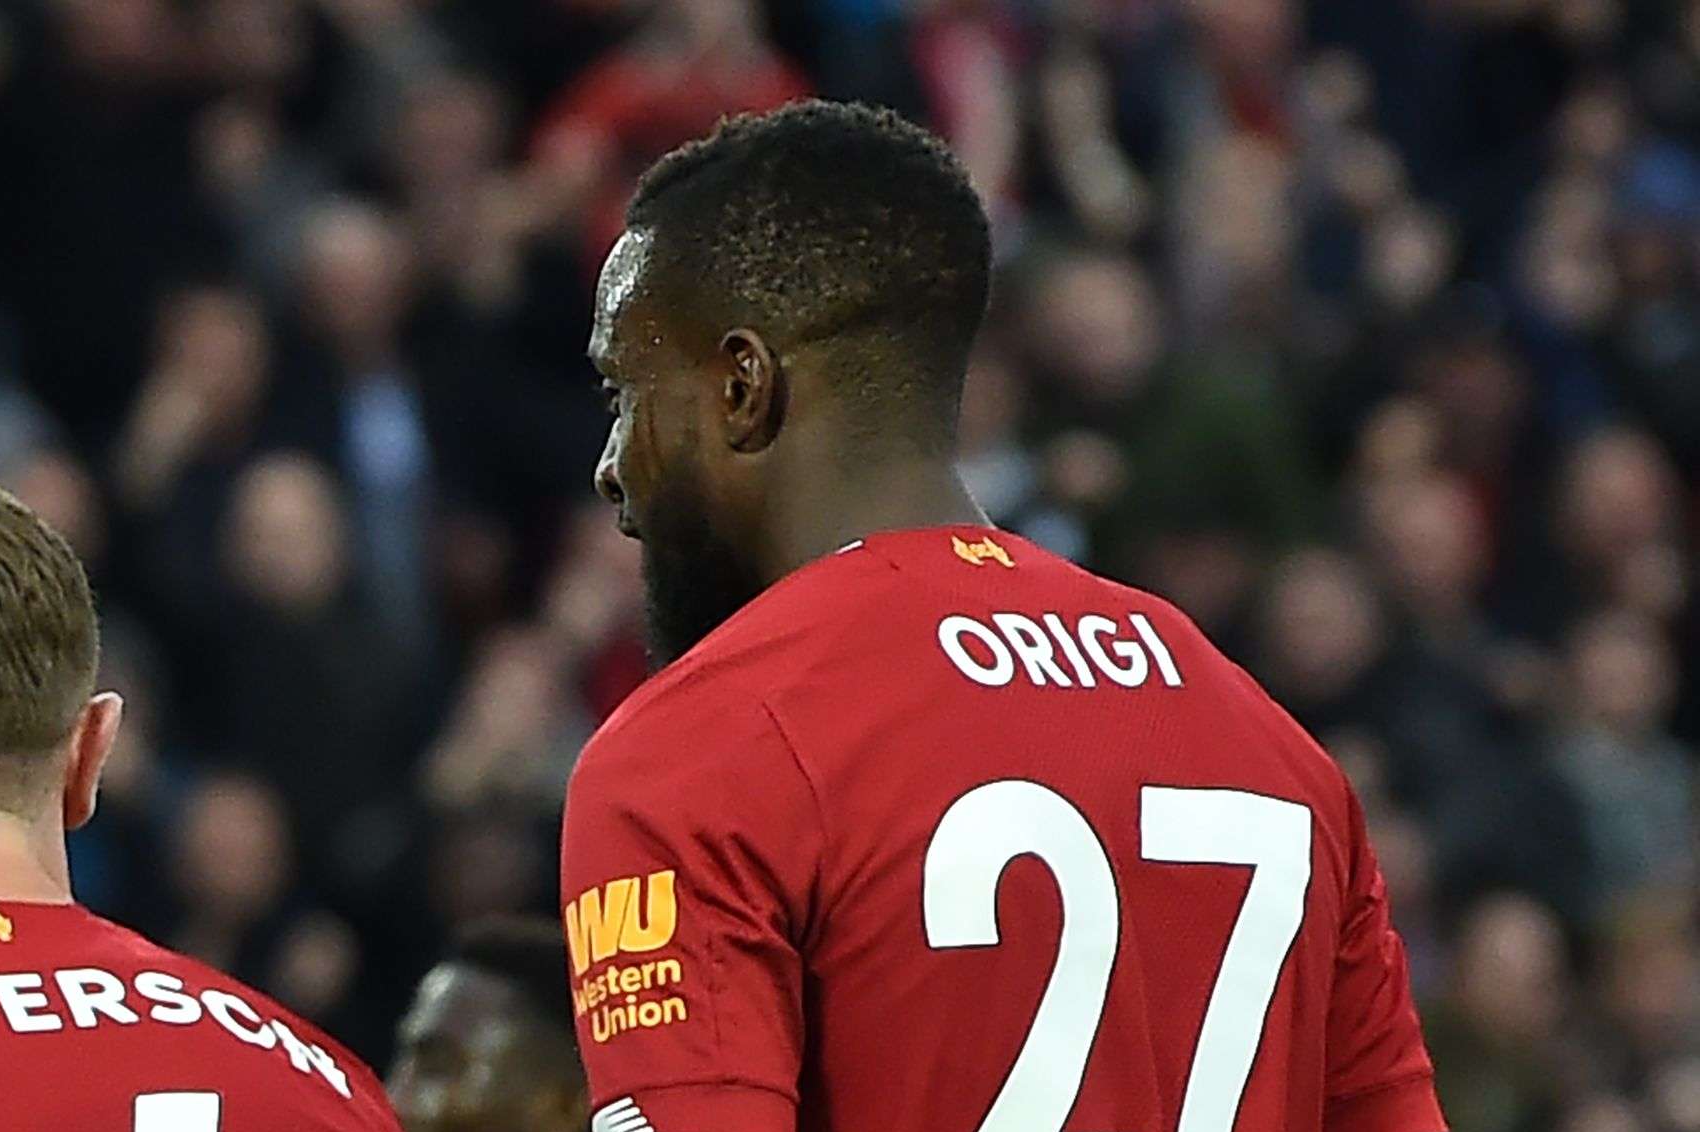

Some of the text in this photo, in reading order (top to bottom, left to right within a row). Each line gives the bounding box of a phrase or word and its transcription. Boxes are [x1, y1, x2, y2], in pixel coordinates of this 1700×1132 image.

[938, 614, 1185, 688] ORIGI
[565, 869, 678, 978] WU
[574, 958, 682, 1017] Western
[591, 995, 688, 1043] Union
